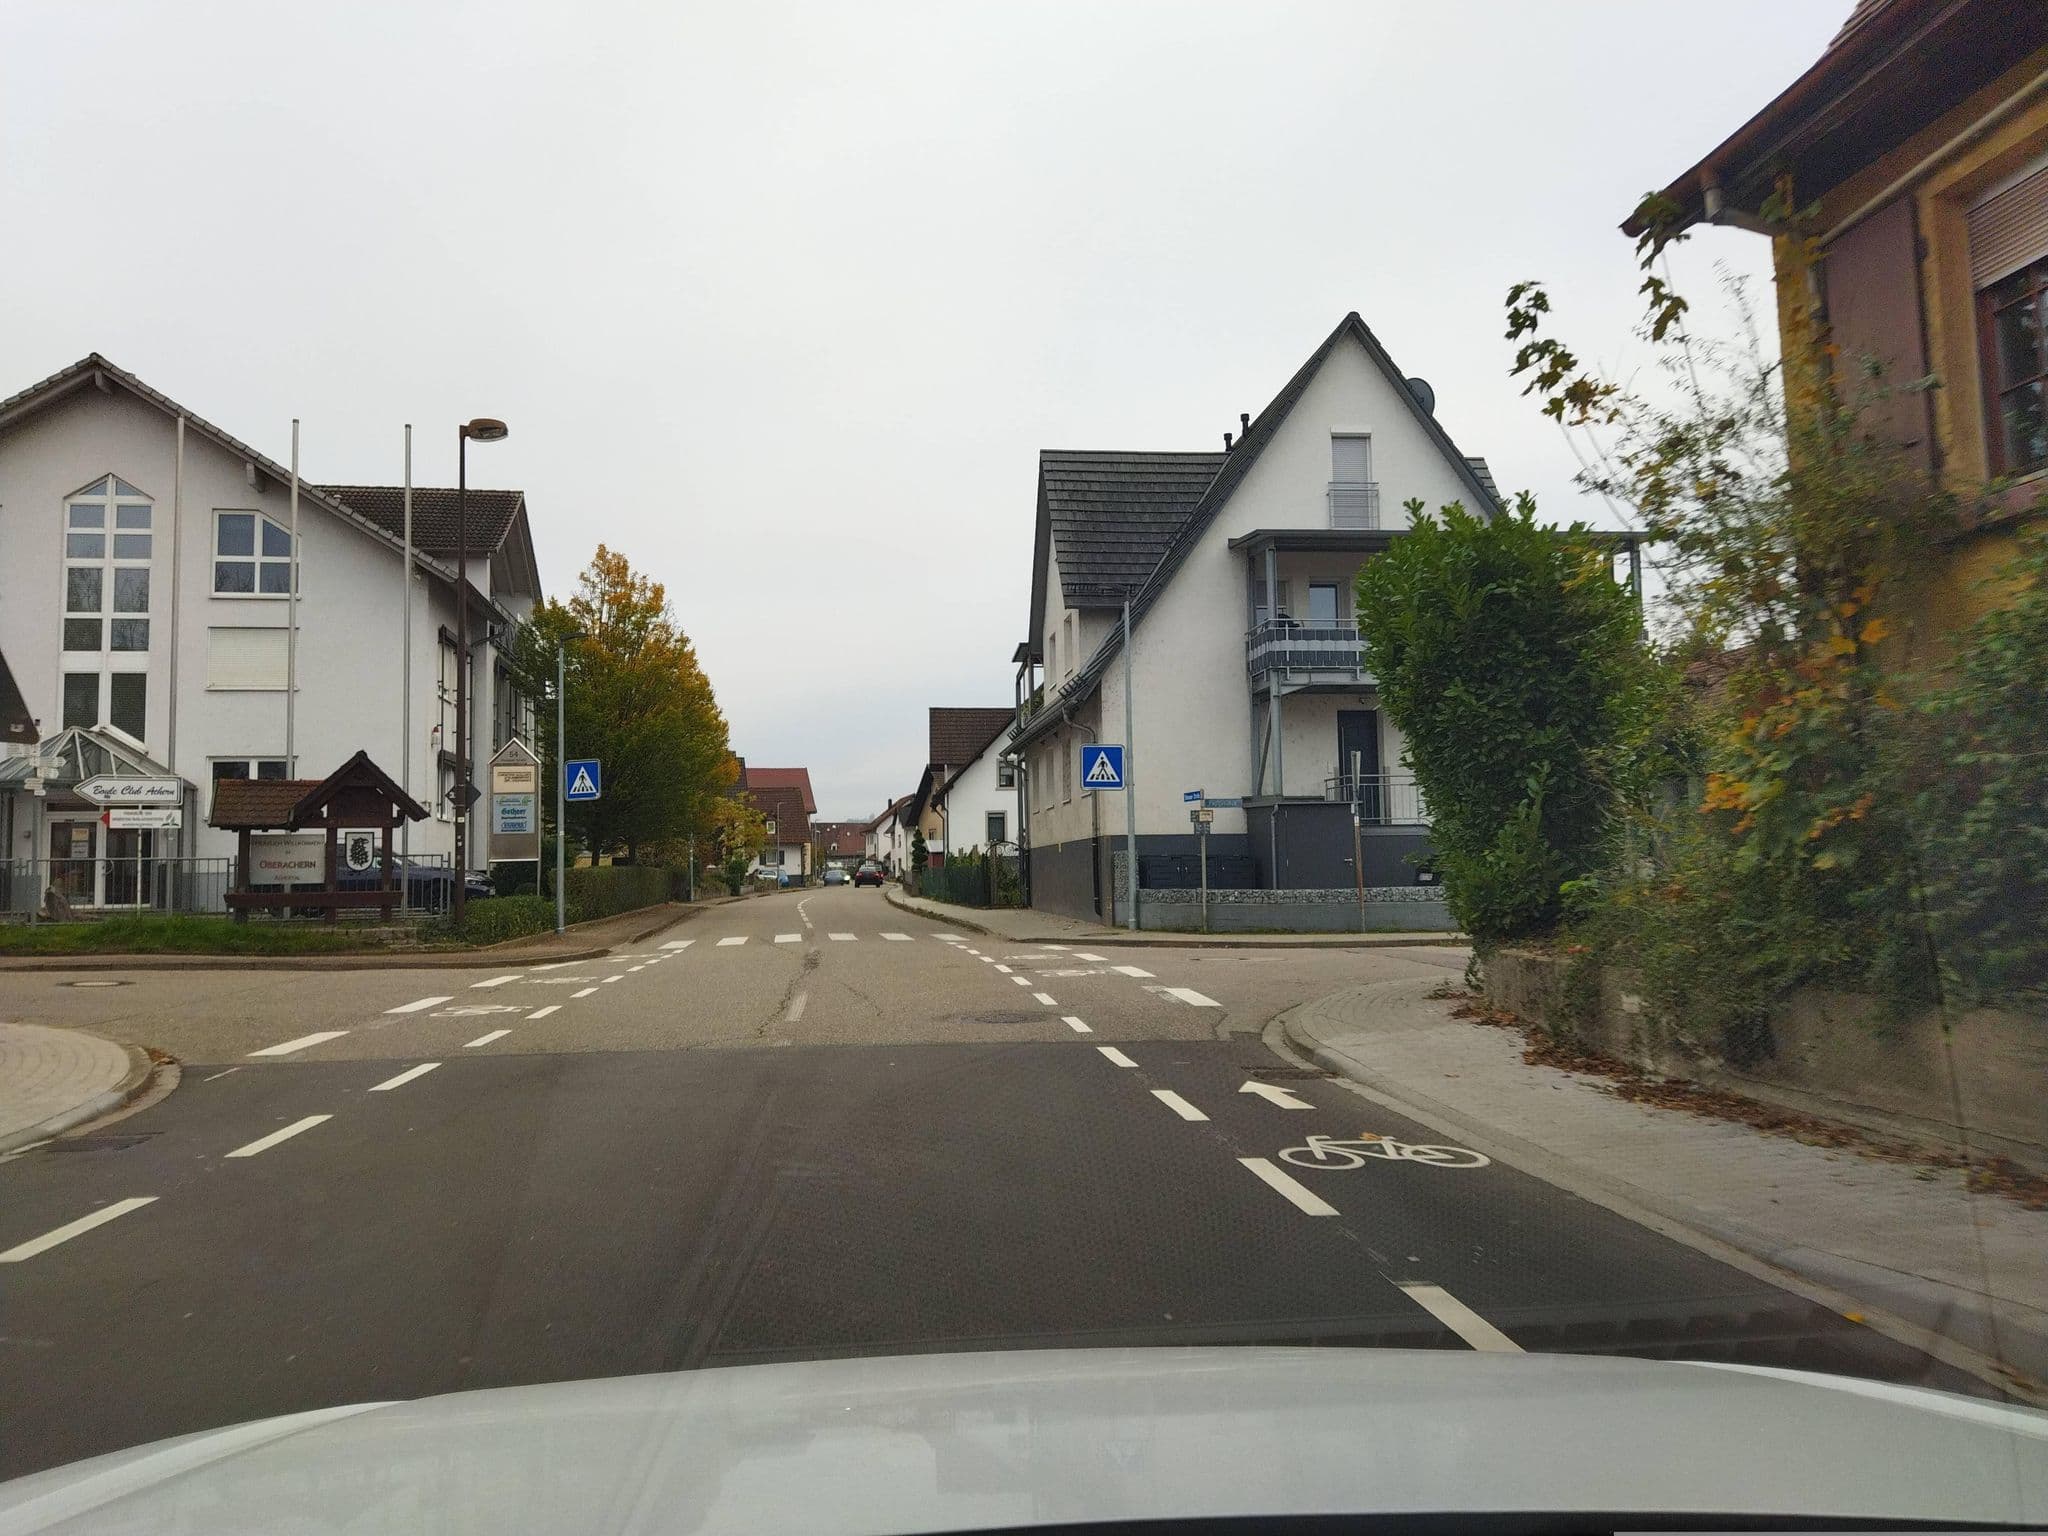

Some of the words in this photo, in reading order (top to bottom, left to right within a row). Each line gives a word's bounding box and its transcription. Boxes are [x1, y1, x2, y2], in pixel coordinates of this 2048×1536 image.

[121, 785, 142, 795] Club
[144, 786, 175, 795] Achern
[259, 860, 316, 868] OBERACHERN
